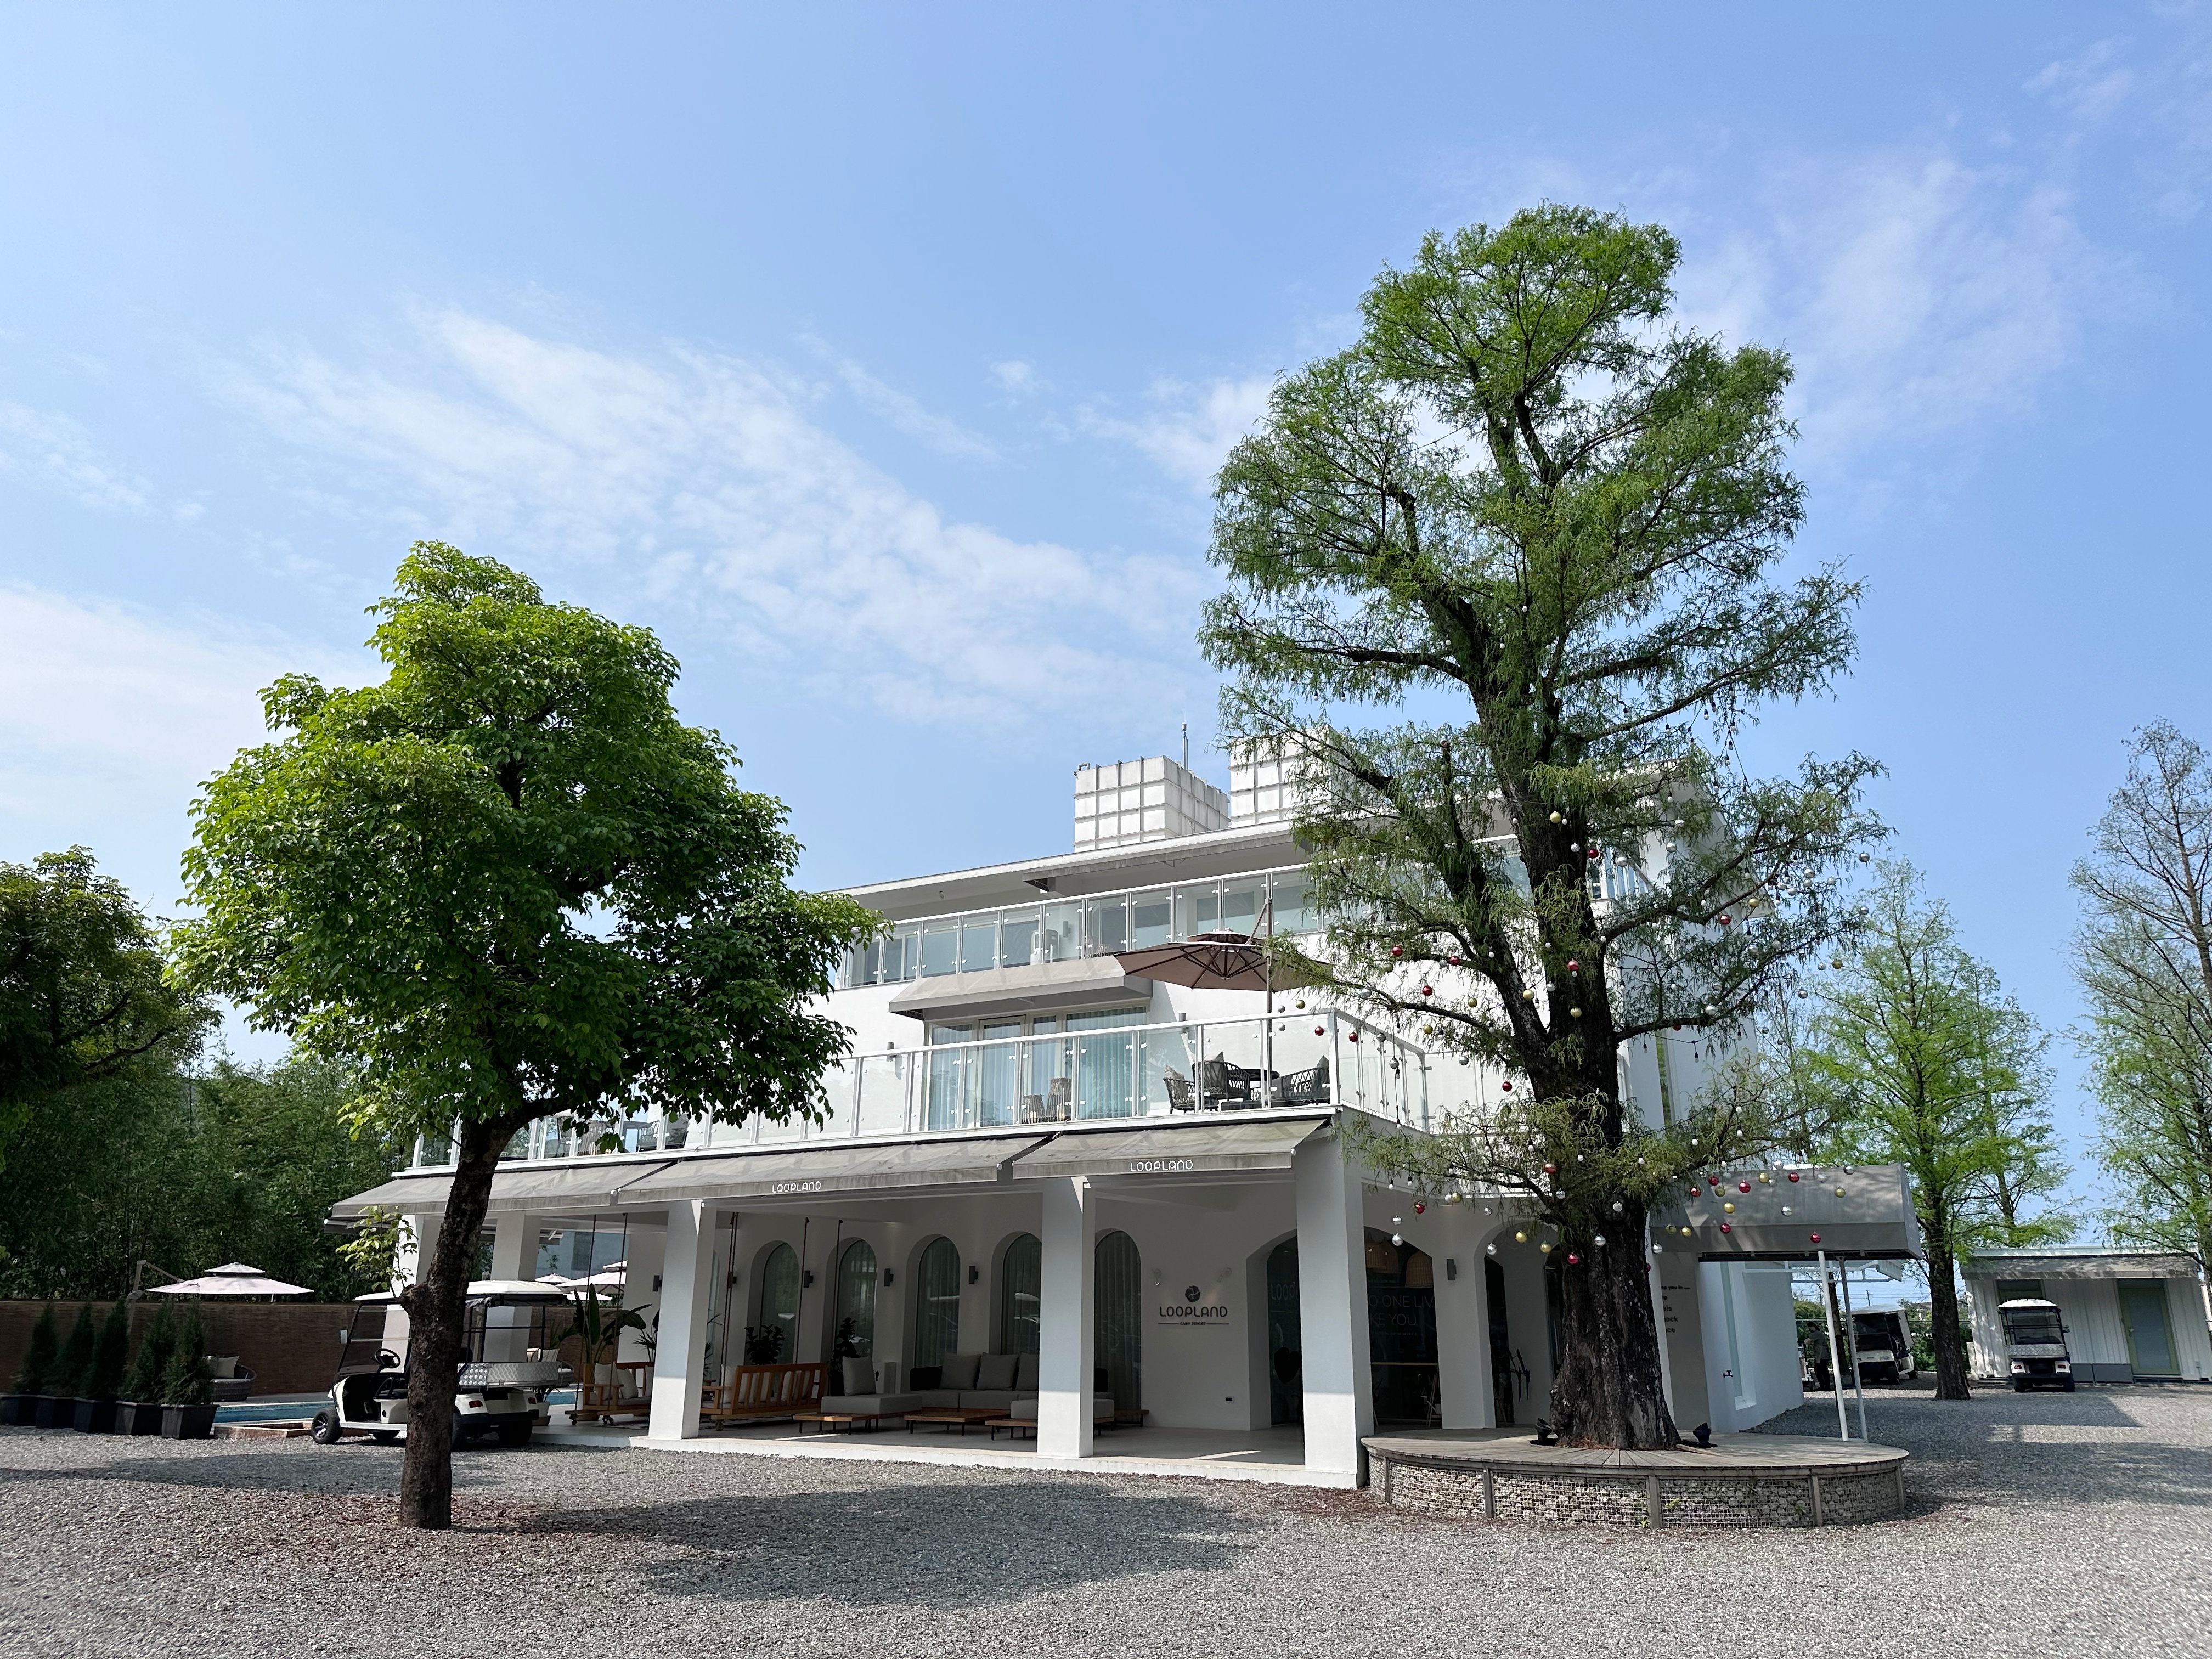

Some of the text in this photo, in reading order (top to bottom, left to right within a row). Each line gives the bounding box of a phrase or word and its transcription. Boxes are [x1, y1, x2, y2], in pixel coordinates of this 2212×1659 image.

[1130, 1159, 1193, 1172] LOOPLAND
[772, 1181, 821, 1193] LOOPLAND
[1368, 1295, 1434, 1308] O ONE LIV
[1159, 1306, 1228, 1317] LOOPLAND
[1370, 1313, 1417, 1328] KE YOU
